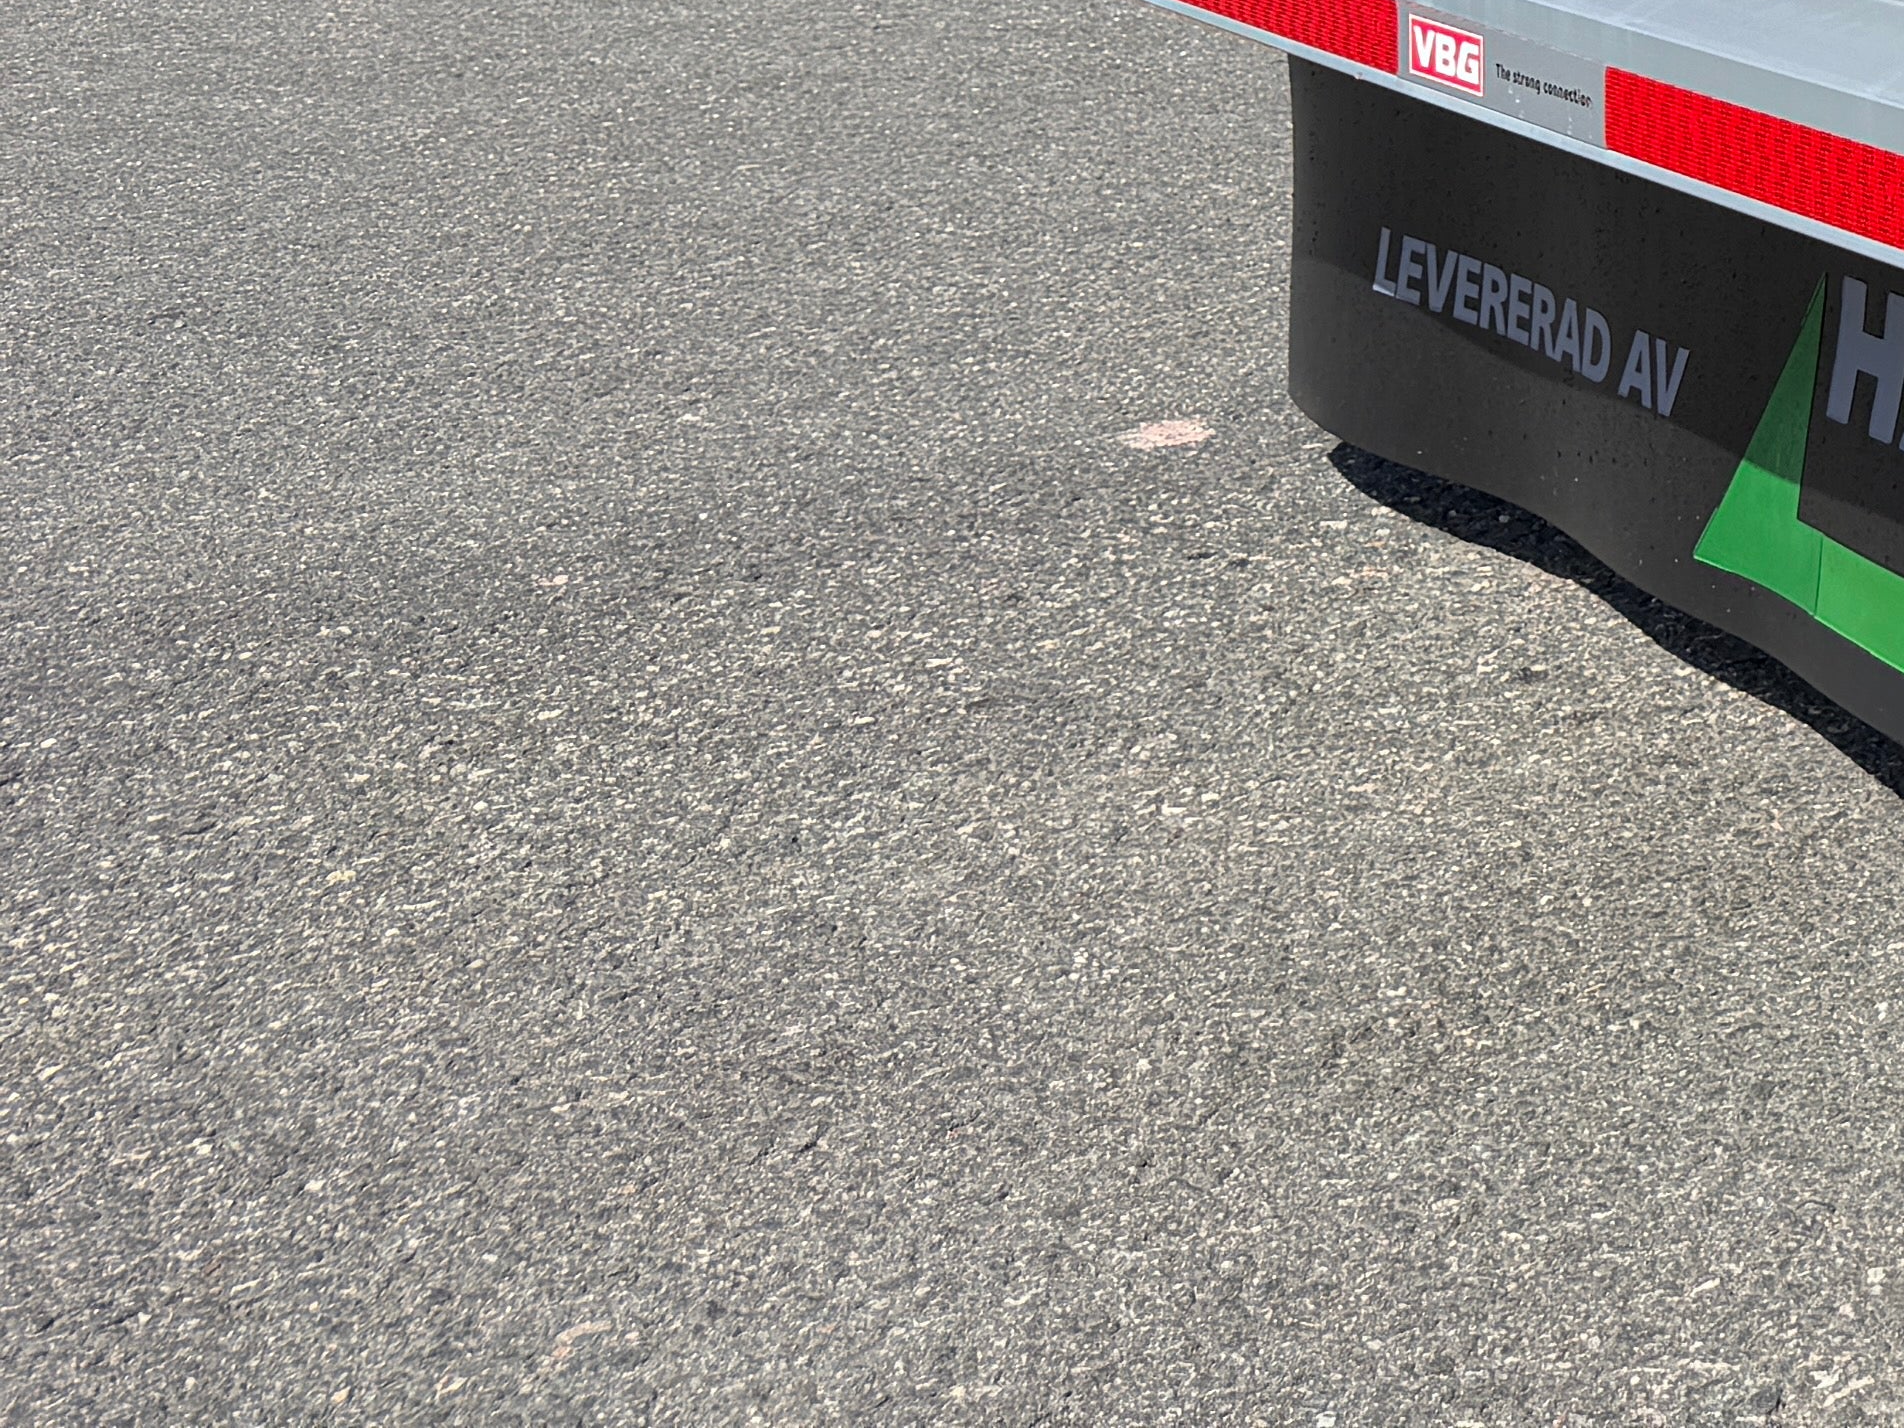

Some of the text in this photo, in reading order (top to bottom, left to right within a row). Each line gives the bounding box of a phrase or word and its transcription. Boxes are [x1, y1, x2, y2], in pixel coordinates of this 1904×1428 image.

[1413, 25, 1480, 85] VBG
[1495, 63, 1593, 109] The strong connection
[1372, 227, 1690, 419] LEVERERAD AV
